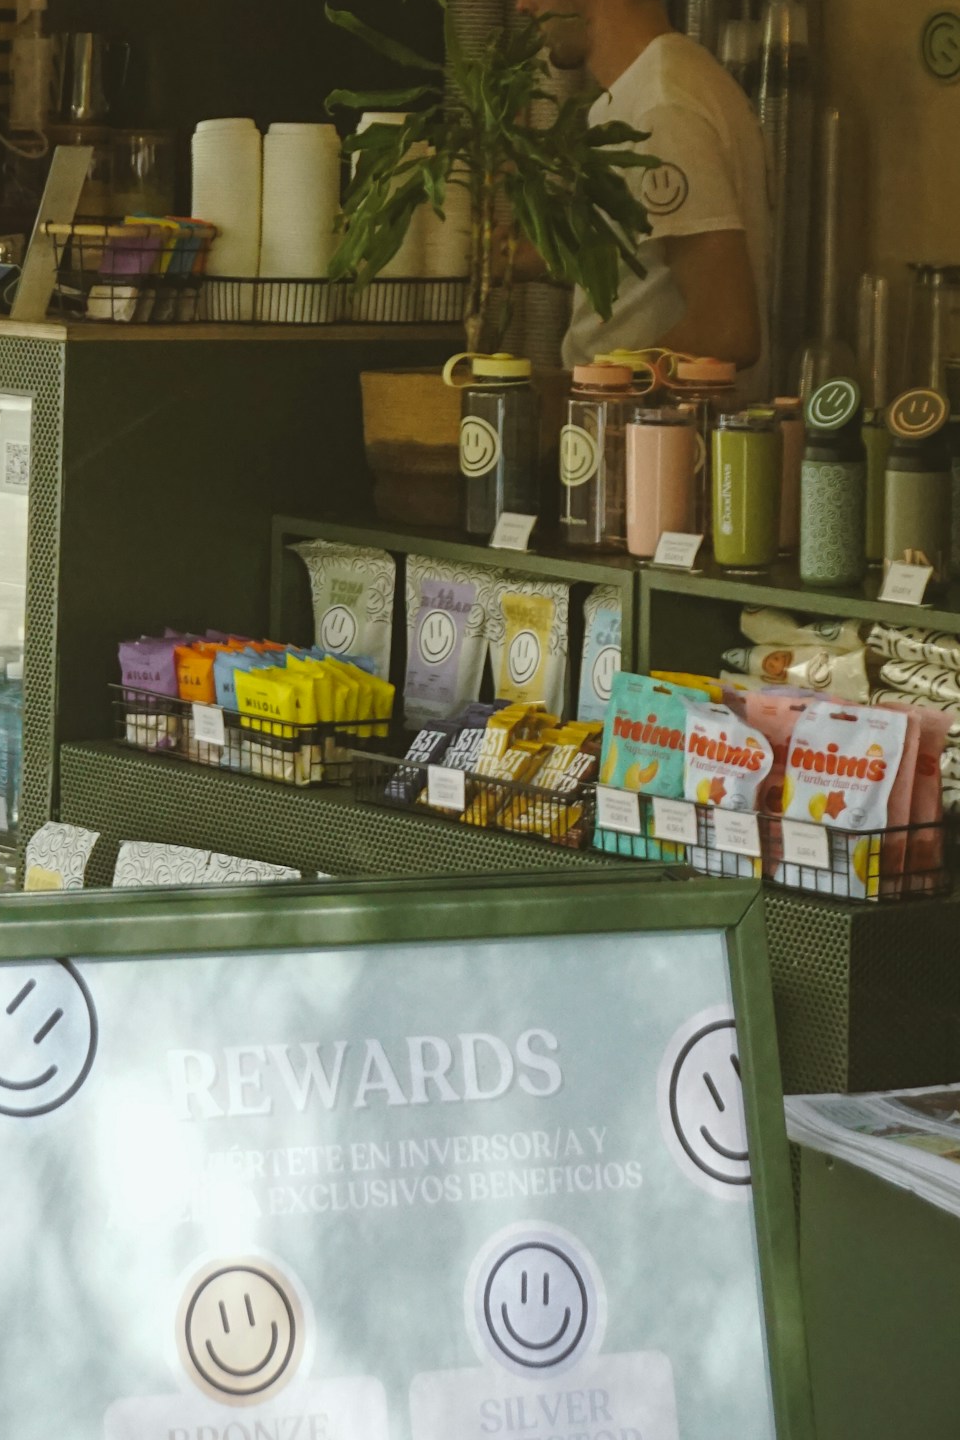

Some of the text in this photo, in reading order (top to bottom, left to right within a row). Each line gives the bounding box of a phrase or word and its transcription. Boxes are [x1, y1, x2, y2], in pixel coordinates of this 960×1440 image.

[410, 729, 448, 752] B3T
[688, 731, 765, 772] mims
[562, 752, 596, 778] B3T
[790, 742, 887, 782] mims
[797, 771, 831, 787] Further
[166, 1028, 563, 1121] REWARDS
[208, 1126, 608, 1178] ÉRTETE EN INVERSOR/A Y
[268, 1173, 463, 1215] EXCLUSIVOS
[468, 1160, 643, 1203] BENEFICIOS
[479, 1388, 613, 1434] SILVER
